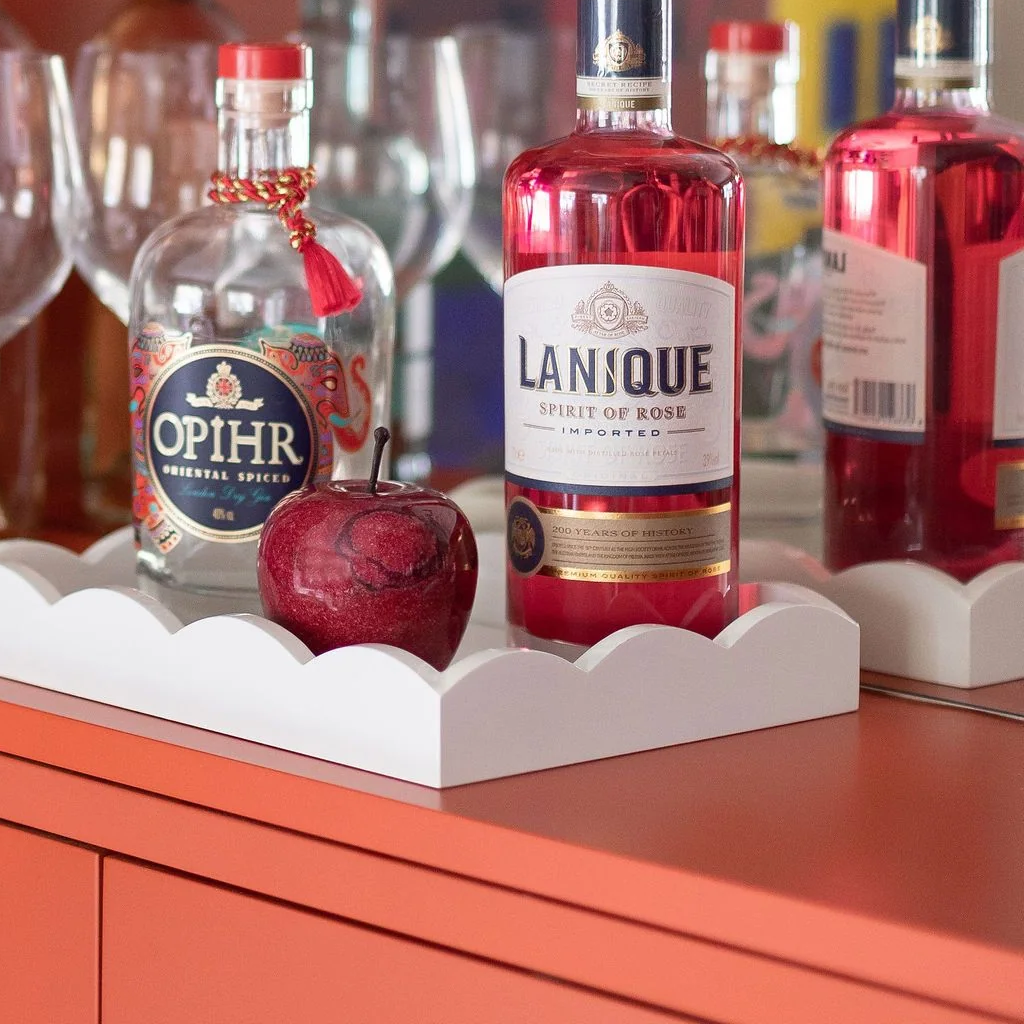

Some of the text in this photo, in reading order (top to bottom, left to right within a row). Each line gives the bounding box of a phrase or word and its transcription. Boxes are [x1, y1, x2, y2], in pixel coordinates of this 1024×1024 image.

[519, 334, 713, 398] LANIQUE
[539, 401, 687, 420] SPIRIT OF ROSE
[153, 411, 304, 466] OPIHR
[562, 427, 660, 437] IMPORTED
[162, 464, 291, 484] ORIENTAL SPICED
[552, 525, 694, 538] 200 YEARS OF HISTORY
